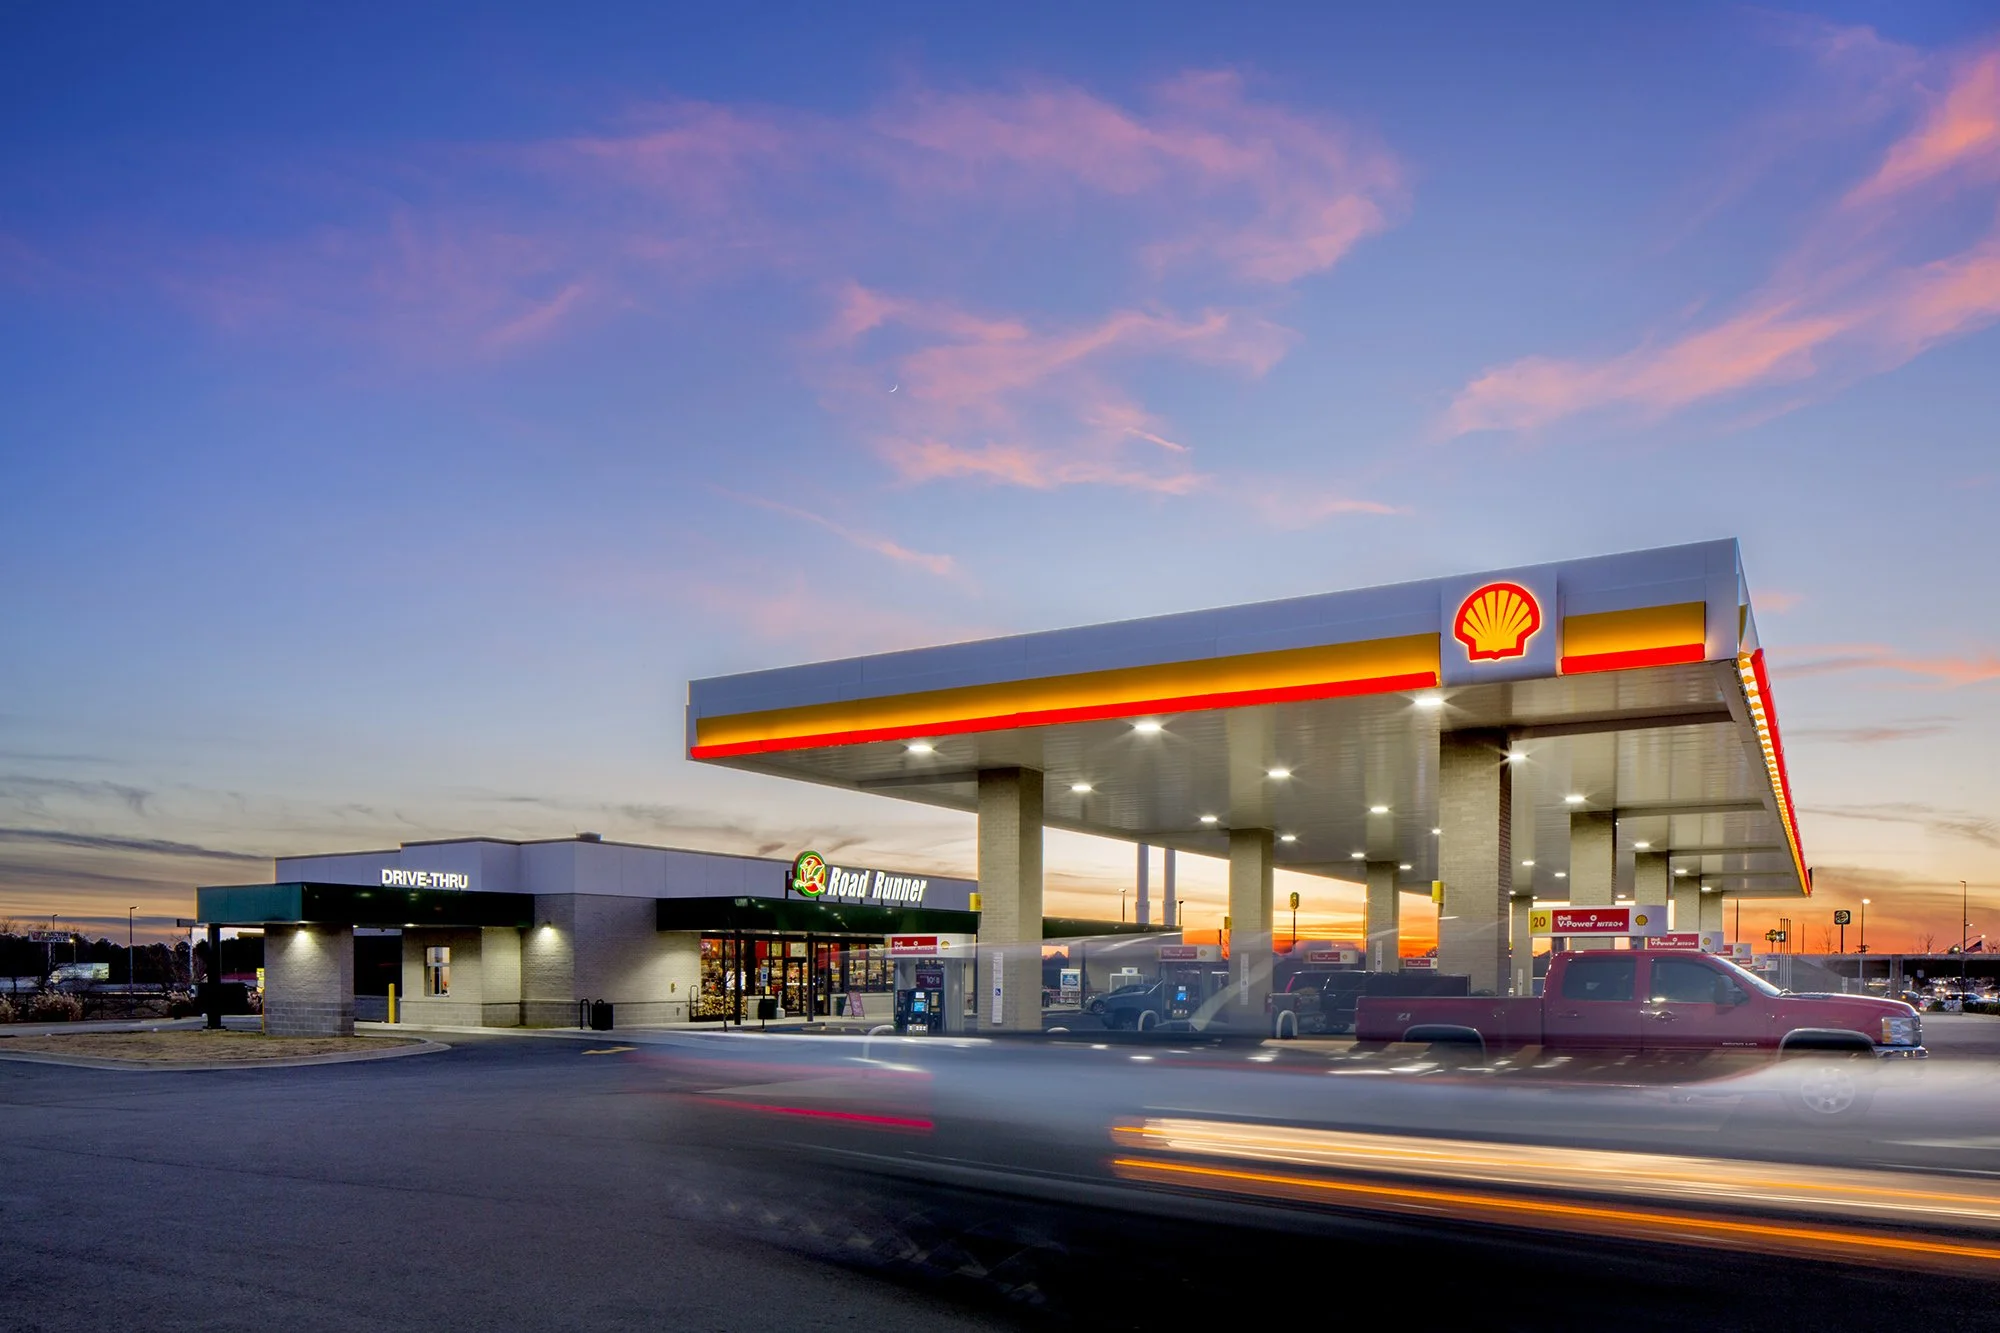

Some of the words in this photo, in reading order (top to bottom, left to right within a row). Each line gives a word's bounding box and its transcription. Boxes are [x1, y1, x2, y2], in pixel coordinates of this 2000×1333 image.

[381, 869, 468, 889] DRIVE-THRU
[827, 867, 871, 898] Road
[872, 871, 927, 902] Runner
[1533, 917, 1546, 928] 20
[1557, 920, 1594, 928] V-Power
